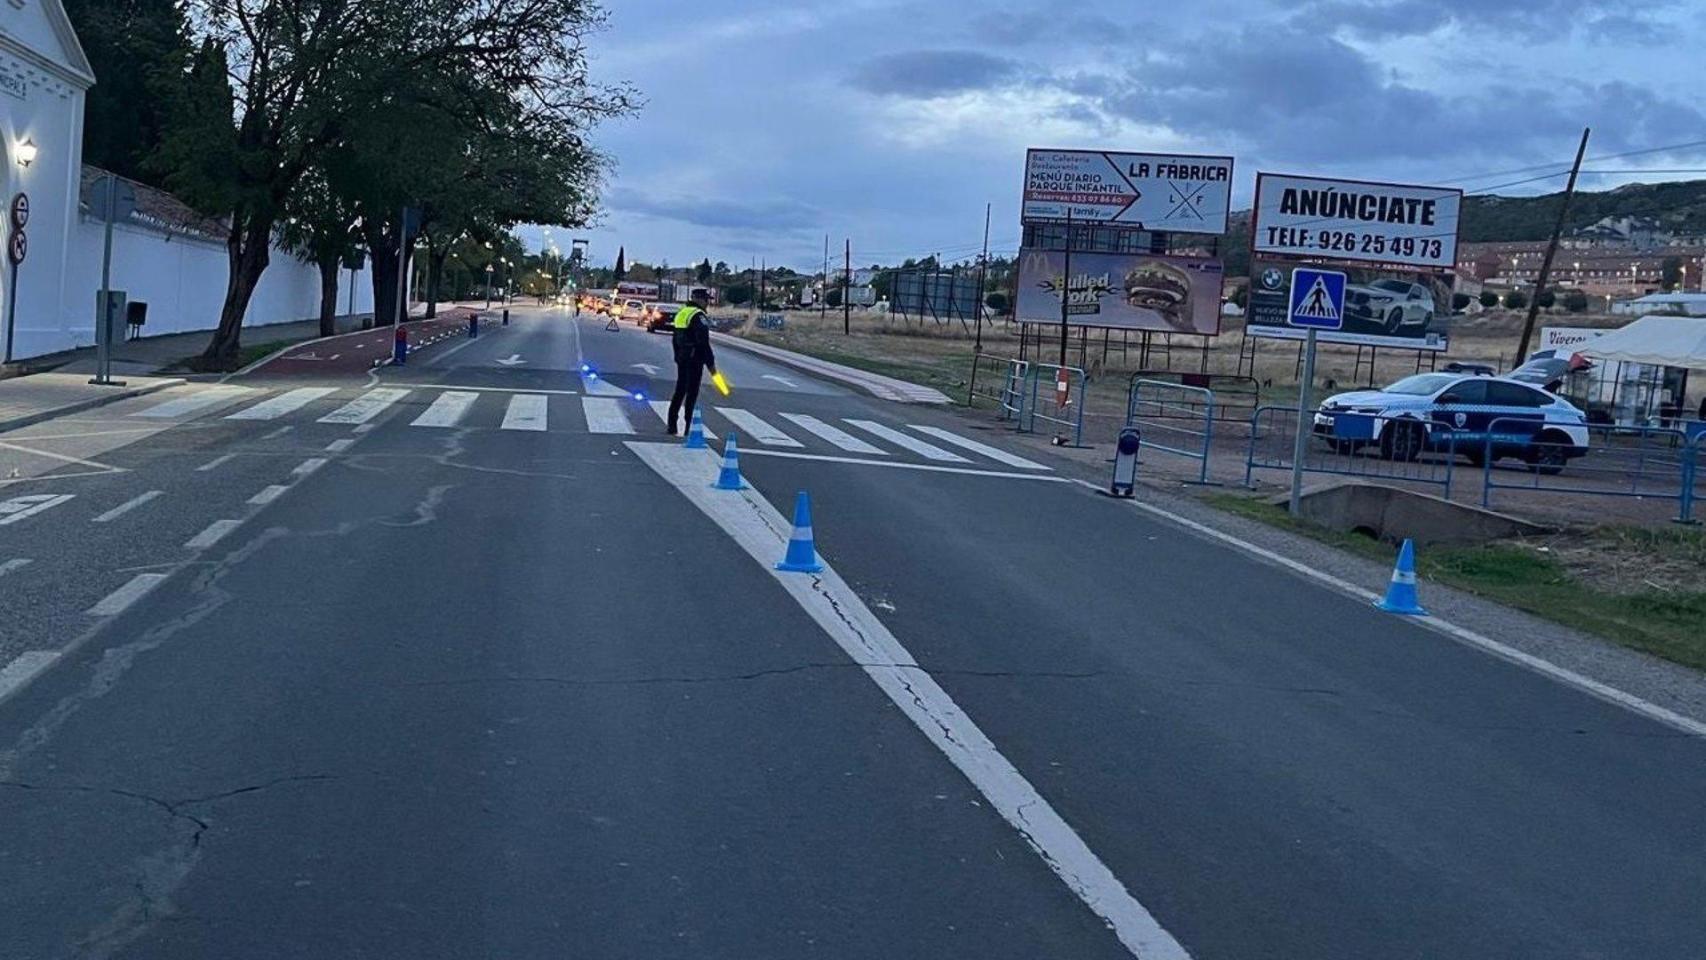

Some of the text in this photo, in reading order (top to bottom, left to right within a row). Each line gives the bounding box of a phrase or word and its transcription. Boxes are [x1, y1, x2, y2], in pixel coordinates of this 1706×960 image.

[1031, 170, 1102, 183] MENÚ DIARIO
[1129, 160, 1228, 181] LA FÁBRICA
[1030, 181, 1123, 193] PARQUE INFANTIL
[1169, 194, 1204, 205] L F
[1280, 187, 1436, 226] ANÚNCIATE
[1268, 226, 1442, 259] TELF: 926 25 49 73
